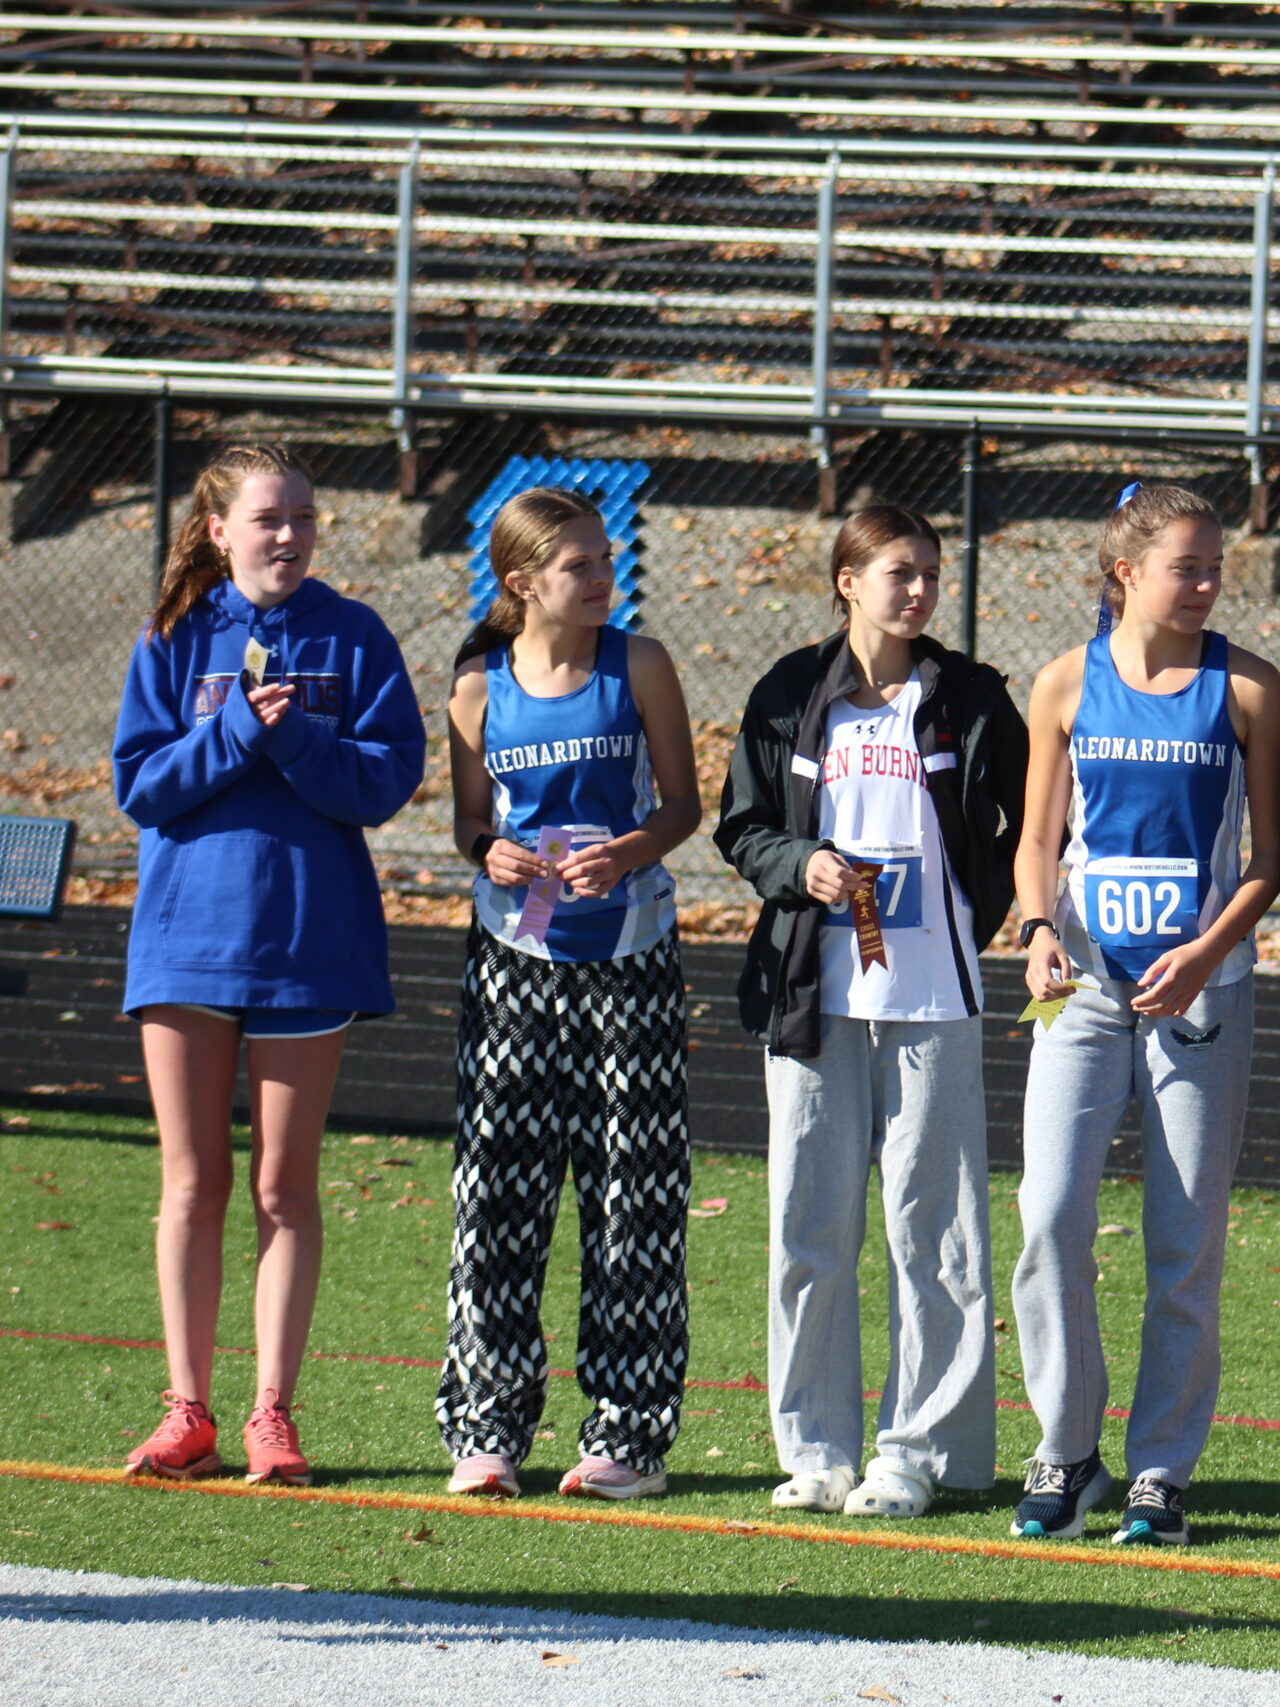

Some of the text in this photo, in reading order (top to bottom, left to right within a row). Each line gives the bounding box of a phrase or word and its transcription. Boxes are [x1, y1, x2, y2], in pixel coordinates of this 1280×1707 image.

[195, 682, 340, 715] ANLIS
[488, 734, 634, 774] LEONARDTOWN
[862, 745, 930, 789] BURN
[1077, 735, 1226, 767] LEONARDTOWN
[1098, 880, 1182, 935] 602
